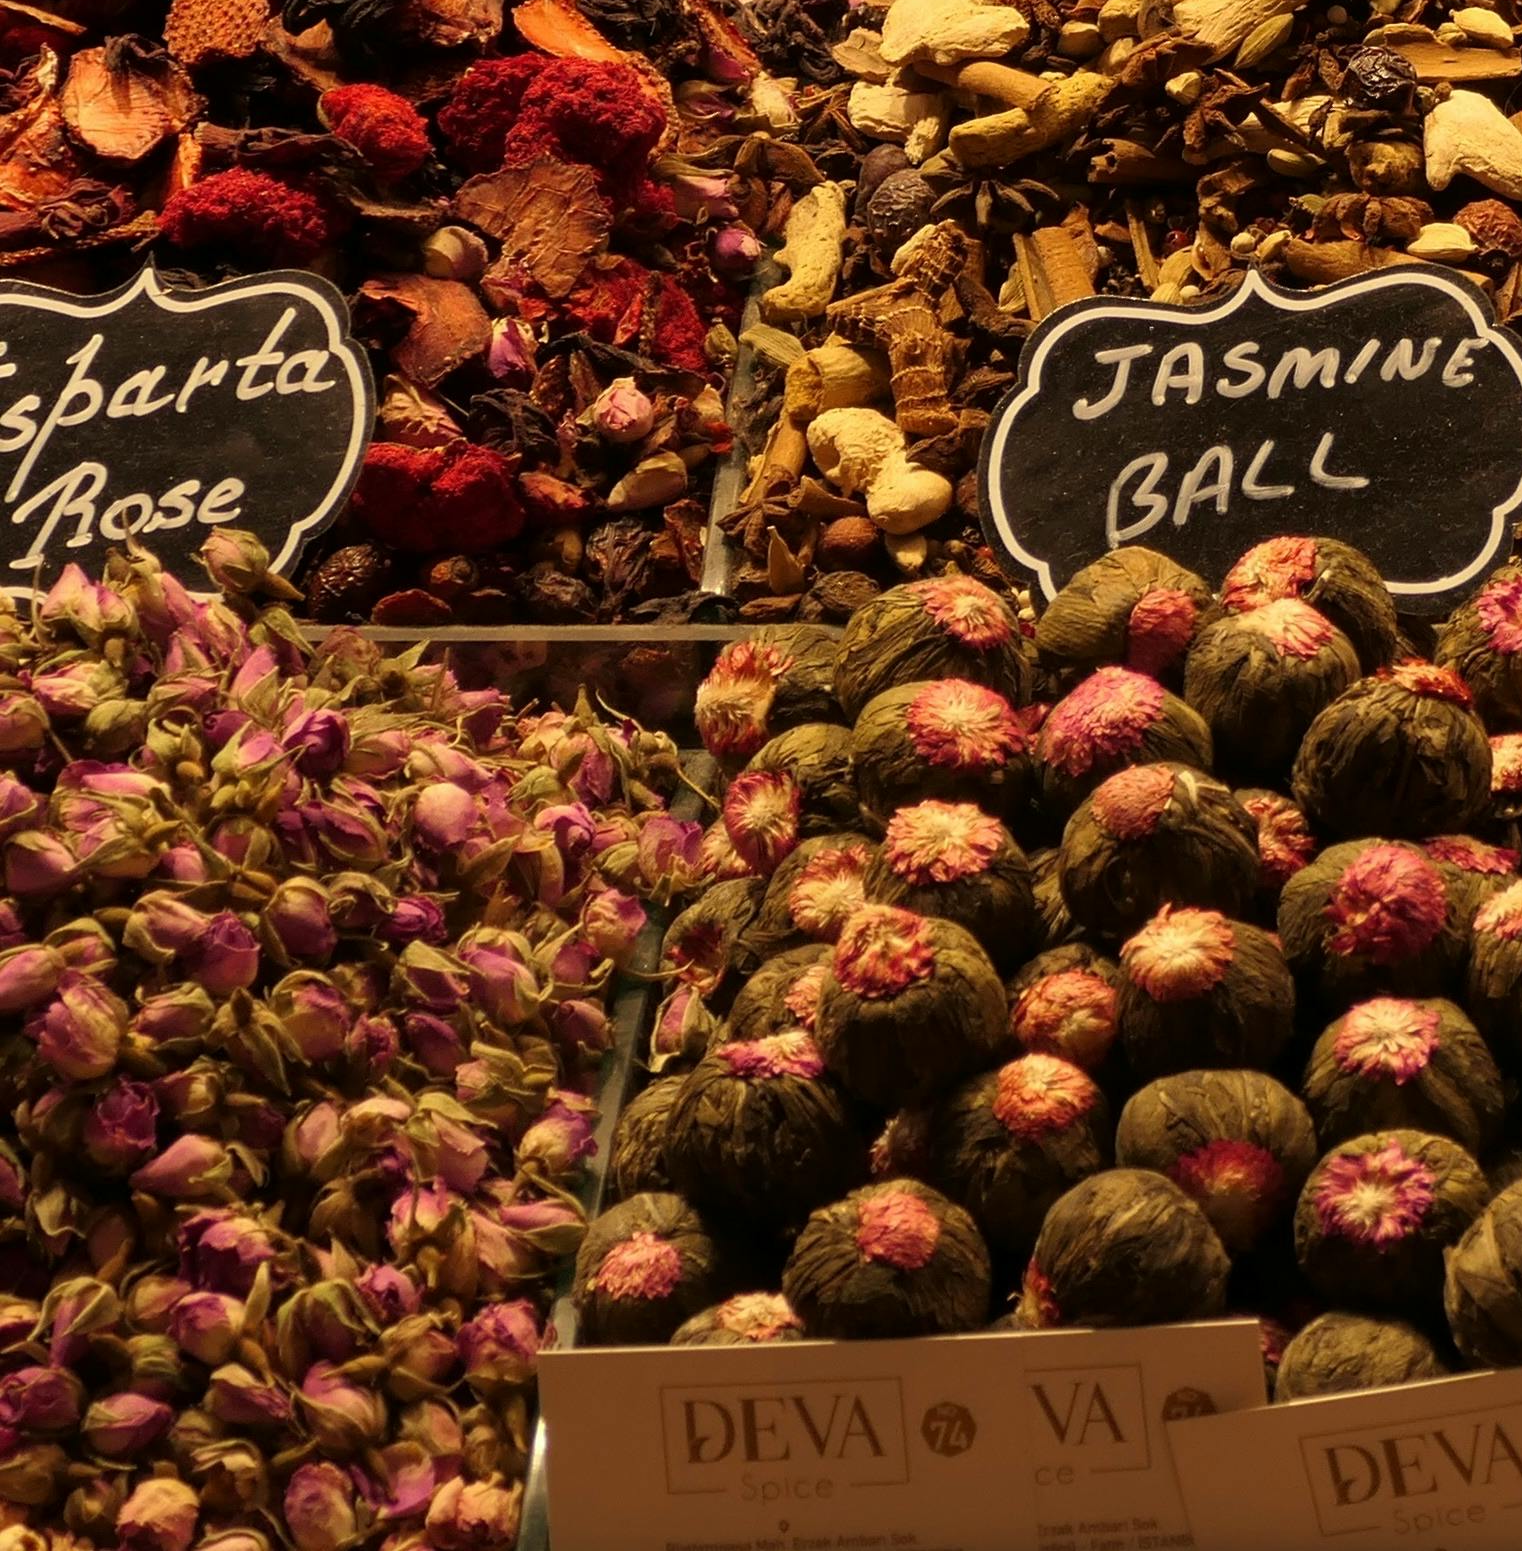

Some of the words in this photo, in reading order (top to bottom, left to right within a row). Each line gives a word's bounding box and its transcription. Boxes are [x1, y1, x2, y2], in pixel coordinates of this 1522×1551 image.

[1072, 337, 1489, 421] JASMINE
[8, 461, 246, 569] Rose
[1106, 432, 1370, 548] BALL
[682, 1394, 887, 1465] DEVA
[929, 1420, 968, 1451] 74
[1031, 1380, 1126, 1446] VA
[740, 1473, 834, 1504] Spice
[1392, 1502, 1487, 1536] Spice
